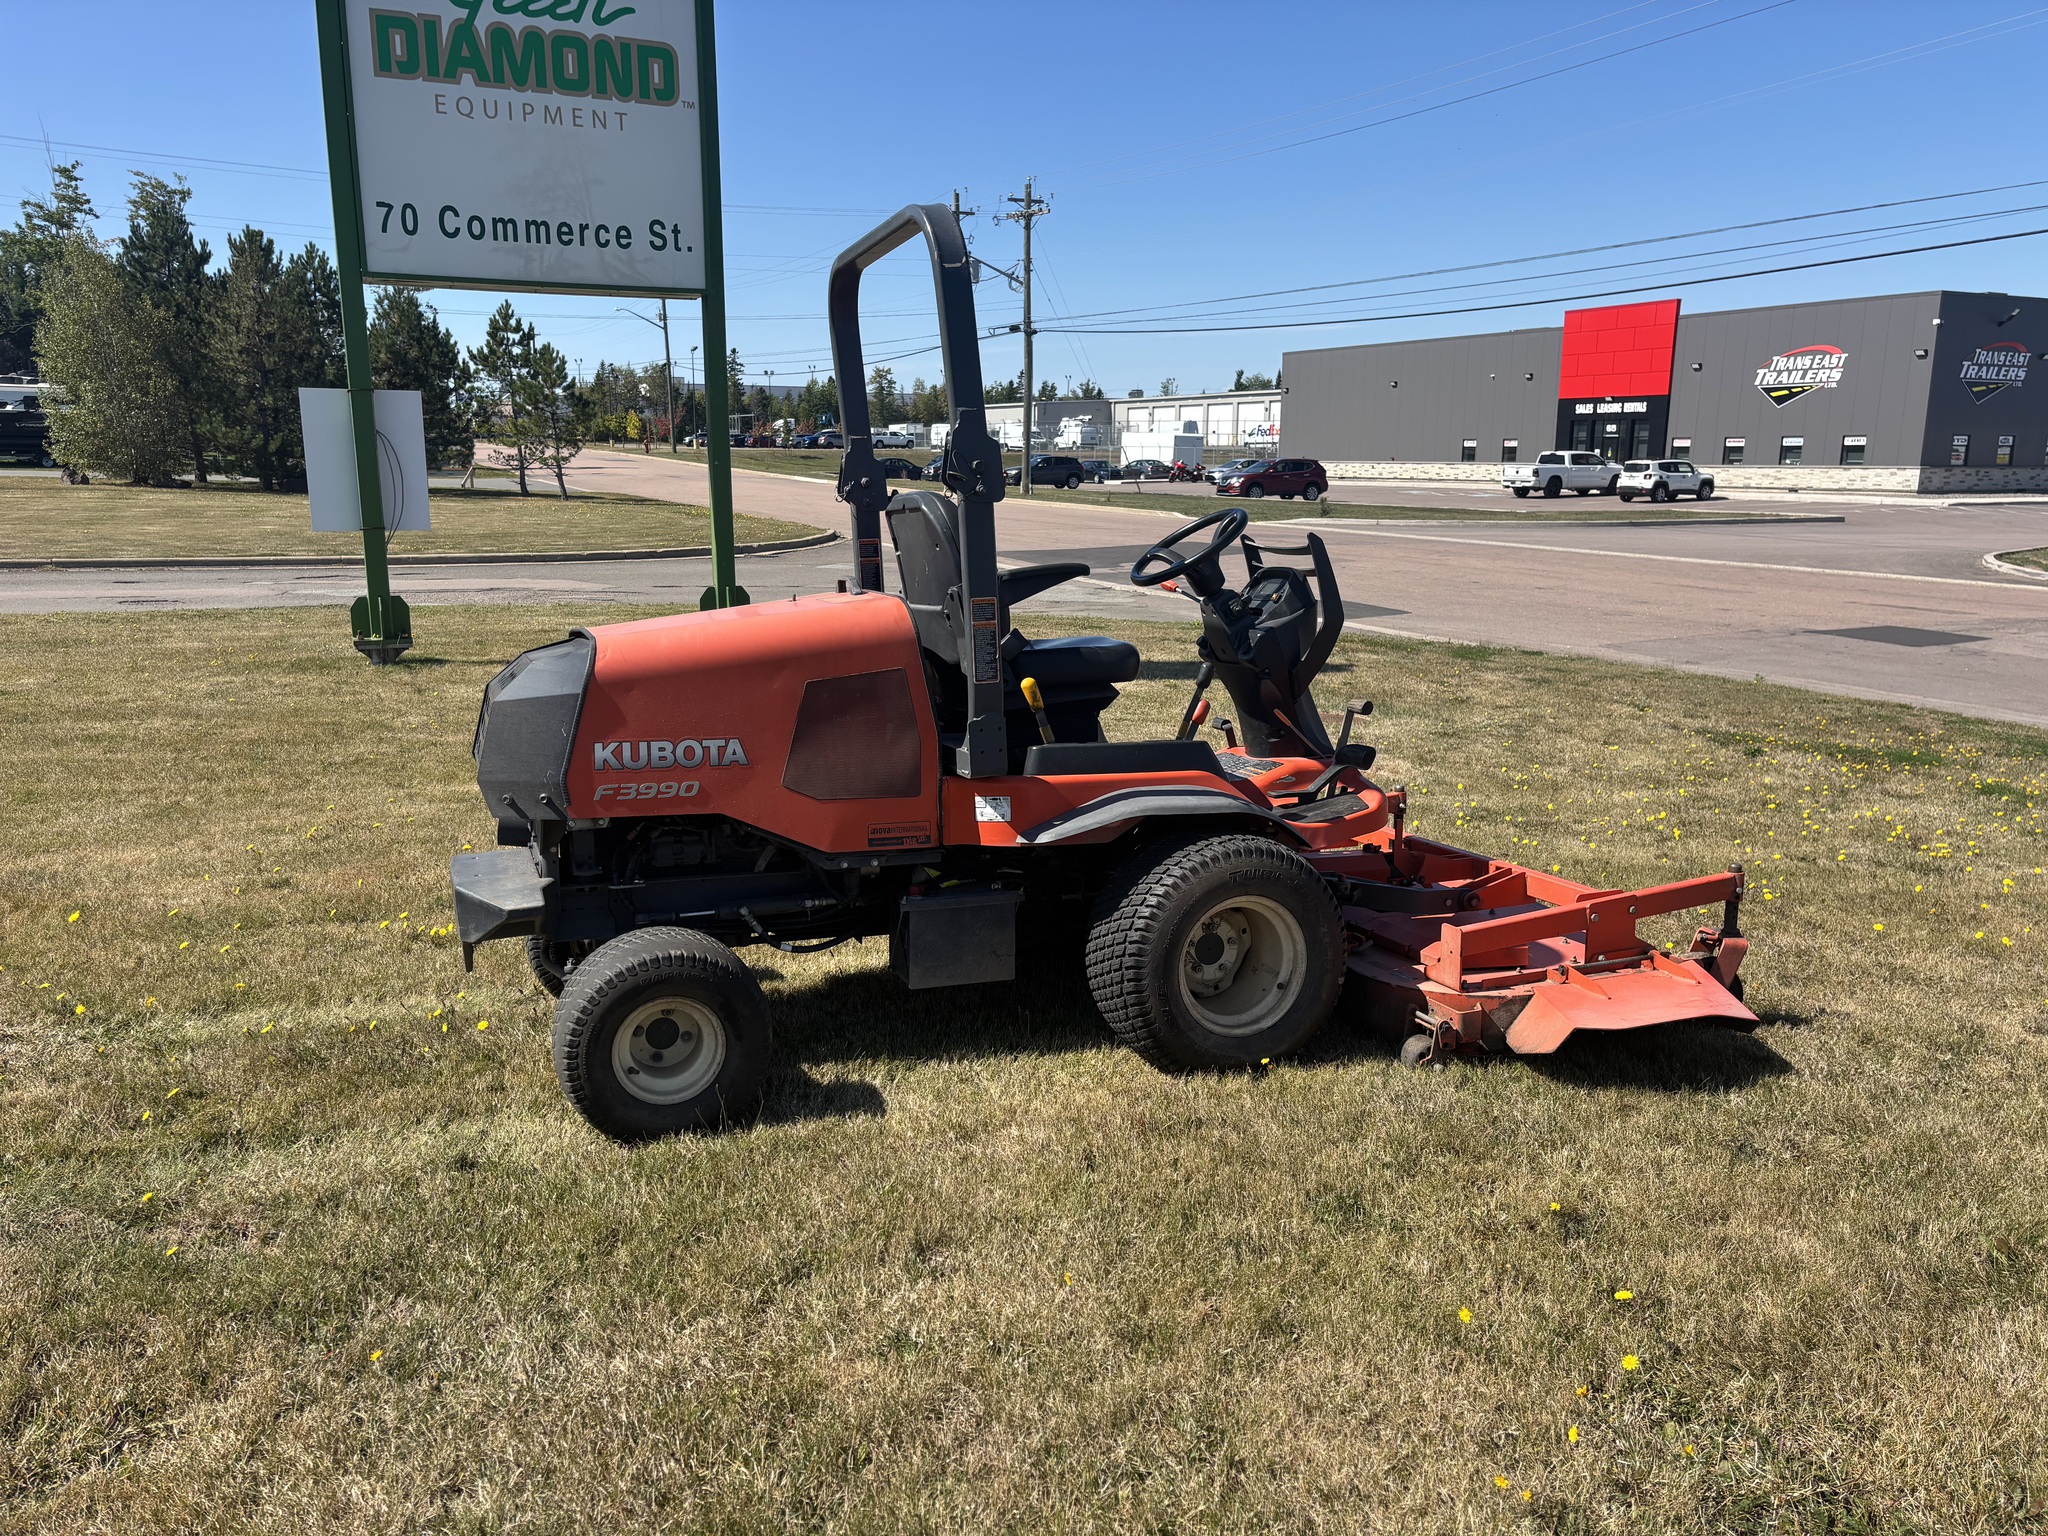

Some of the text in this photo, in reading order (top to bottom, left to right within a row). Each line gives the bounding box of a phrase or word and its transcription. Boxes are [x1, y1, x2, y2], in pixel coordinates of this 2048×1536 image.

[370, 9, 680, 106] DIAMOND
[434, 94, 628, 132] EQUIPMENT
[375, 201, 693, 253] 70 Commerce St.
[1769, 353, 1849, 371] TRANS EAST
[1959, 361, 2028, 380] TRAILERS
[1753, 368, 1844, 386] TRAILERS
[1575, 402, 1647, 414] SALES LEASING RENTALS
[593, 738, 749, 771] KUBOTA
[593, 781, 701, 801] F3990
